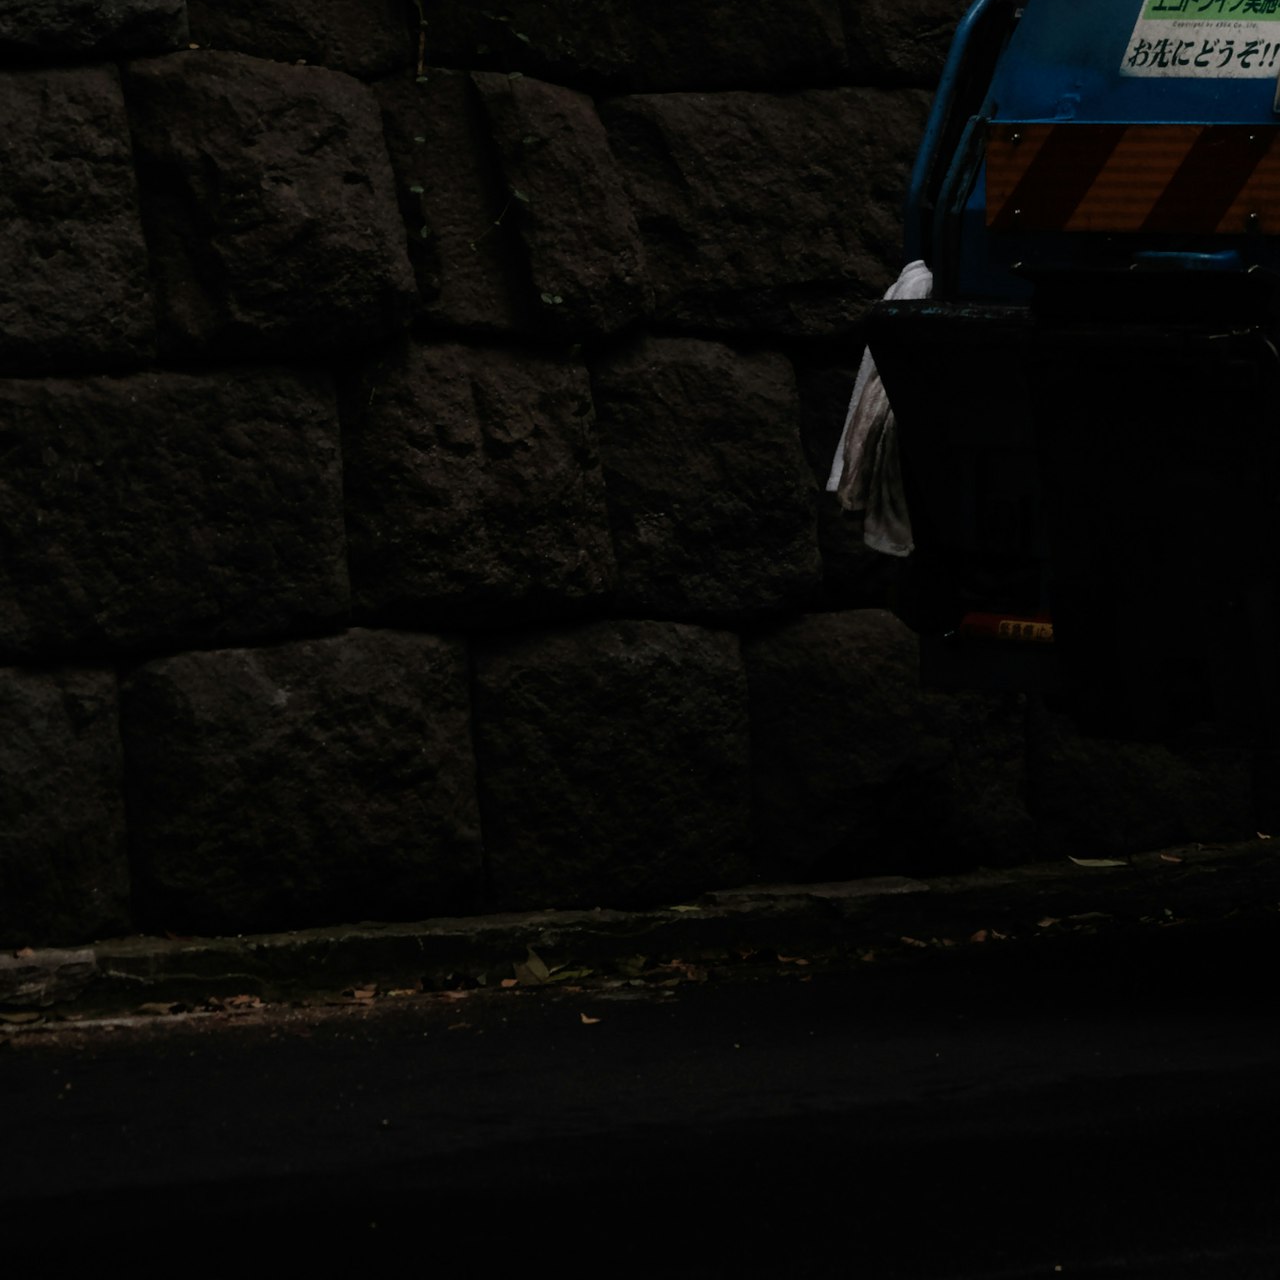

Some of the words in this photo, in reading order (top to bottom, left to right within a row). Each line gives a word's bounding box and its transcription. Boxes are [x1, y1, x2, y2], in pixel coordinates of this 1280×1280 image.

[1128, 38, 1280, 68] お先にどうぞ!!
